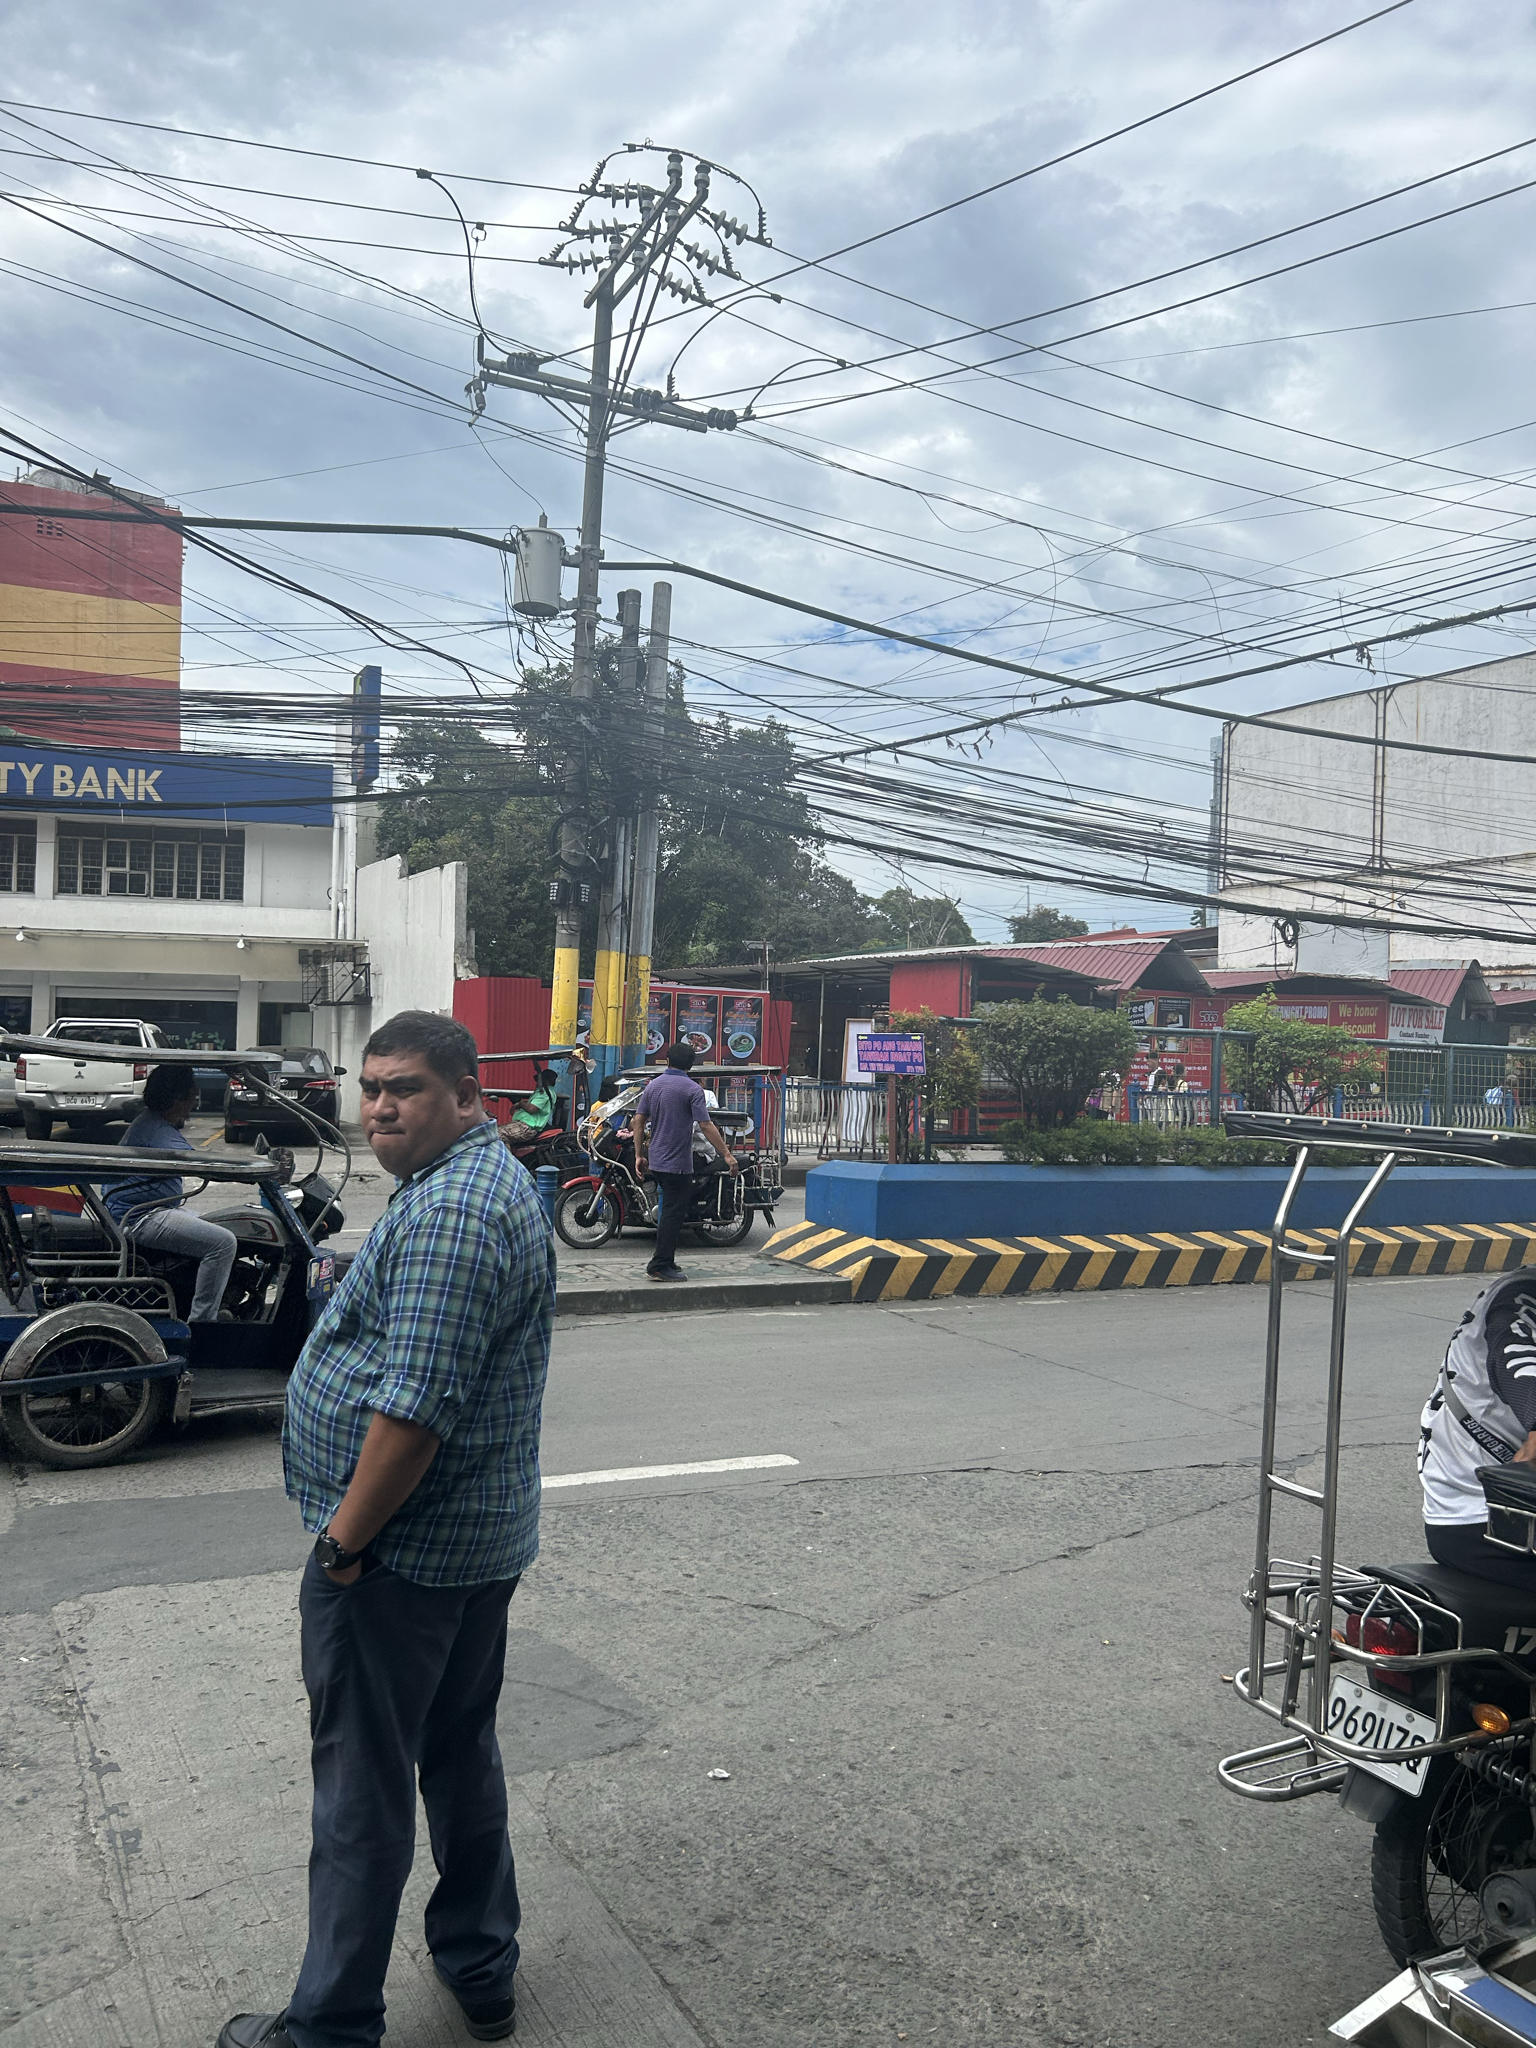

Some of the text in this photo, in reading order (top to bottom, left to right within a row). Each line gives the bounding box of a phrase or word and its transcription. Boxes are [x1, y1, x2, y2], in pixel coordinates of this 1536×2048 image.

[0, 761, 164, 802] TY BANK
[1198, 1010, 1219, 1023] SOGO
[1304, 1005, 1328, 1019] PROMO
[1338, 1003, 1379, 1017] We honor
[1390, 1006, 1445, 1030] LOT FOR SALE
[1342, 1022, 1377, 1035] discount
[1399, 1030, 1414, 1038] Contact
[857, 1040, 922, 1052] DITO PO ANG TAMANG
[890, 1051, 912, 1063] INGAT
[912, 1052, 923, 1063] PO
[1503, 1626, 1536, 1655] 17
